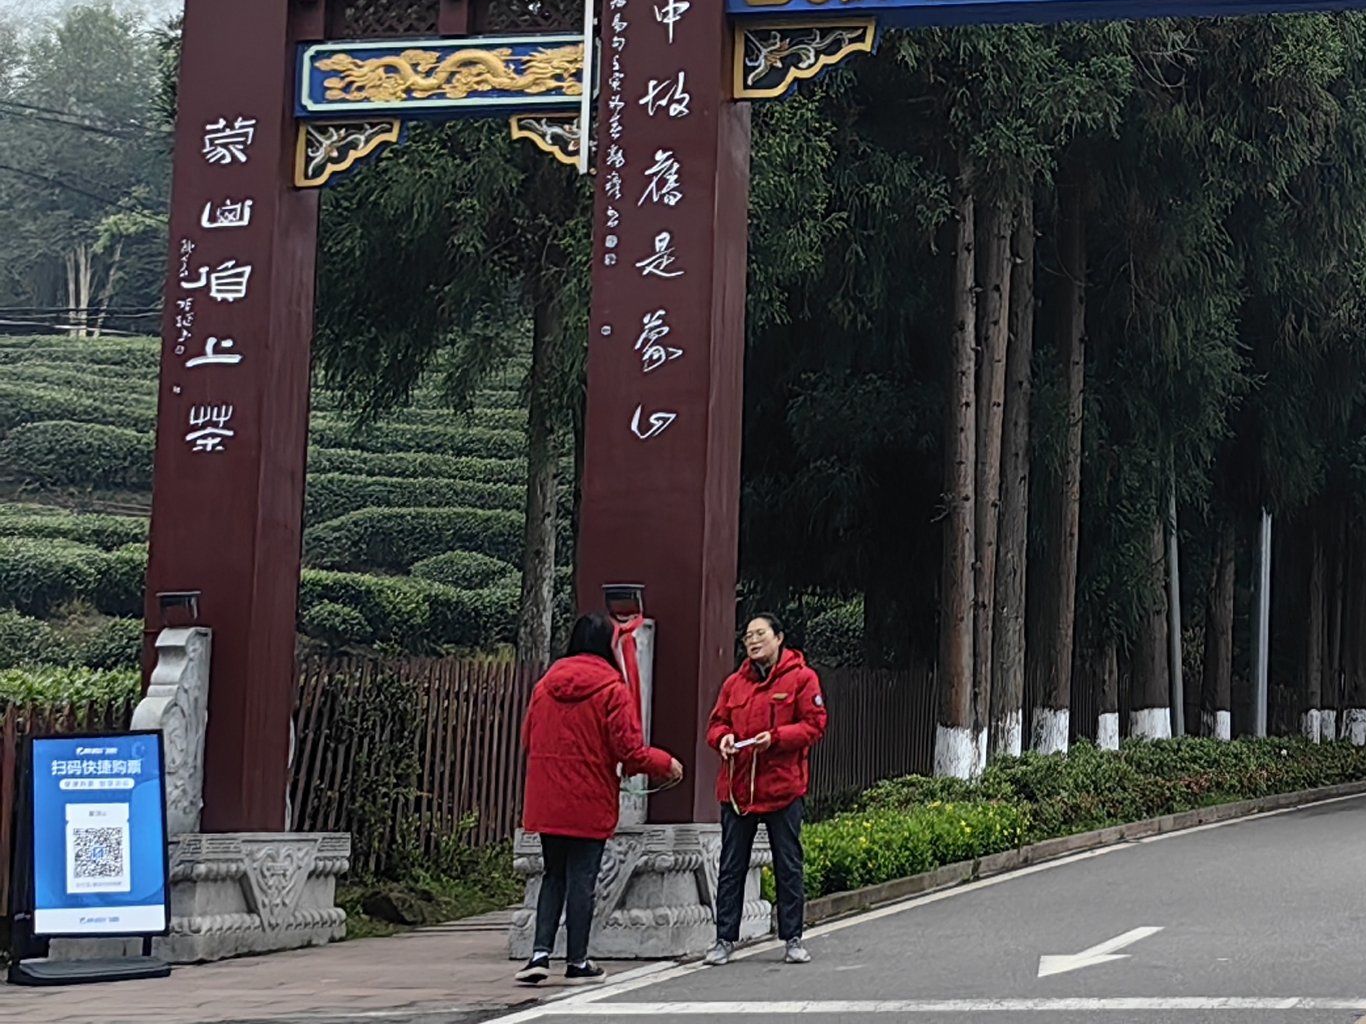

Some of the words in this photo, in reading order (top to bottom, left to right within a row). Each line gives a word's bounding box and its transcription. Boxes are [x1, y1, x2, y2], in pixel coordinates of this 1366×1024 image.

[51, 759, 142, 775] 扫码快捷购票
